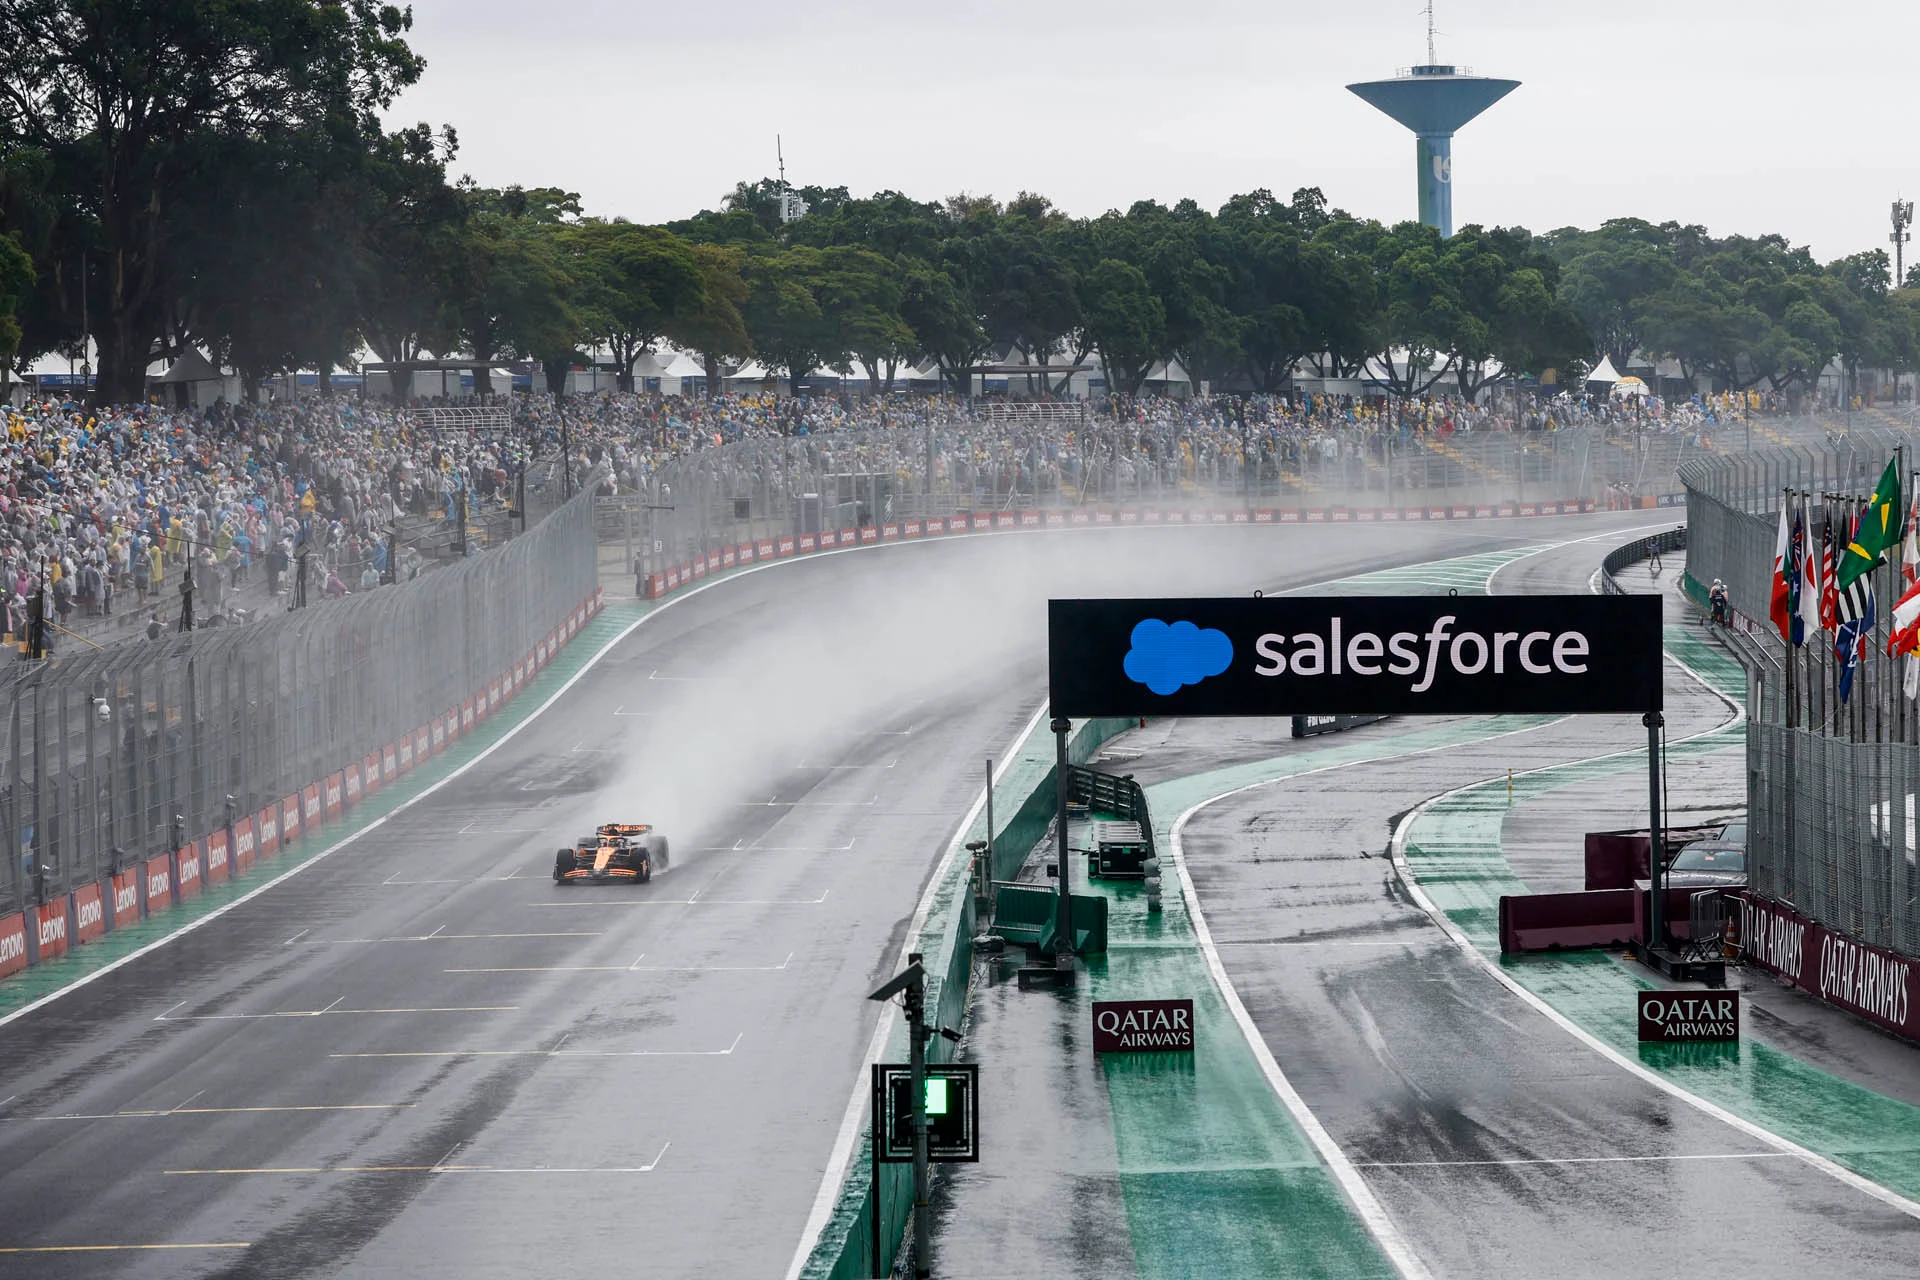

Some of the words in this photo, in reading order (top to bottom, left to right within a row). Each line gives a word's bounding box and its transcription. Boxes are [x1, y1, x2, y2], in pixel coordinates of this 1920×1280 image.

[1255, 615, 1589, 692] salesforce
[208, 845, 227, 870] Lenovo
[236, 831, 254, 857] Lenovo
[179, 857, 199, 884] Lenovo
[114, 885, 137, 912] Lenovo
[148, 872, 169, 898] Lenovo
[78, 899, 102, 928] Lenovo
[39, 916, 65, 945] Lenovo
[0, 932, 24, 963] enovo
[1821, 934, 1855, 1003] QATAR
[1854, 948, 1909, 1026] AIRWAYS
[1098, 1009, 1189, 1036] QATAR
[1643, 1000, 1734, 1025] QATAR
[1120, 1031, 1190, 1047] AIRWAYS
[1664, 1022, 1735, 1036] AIRWAYS
